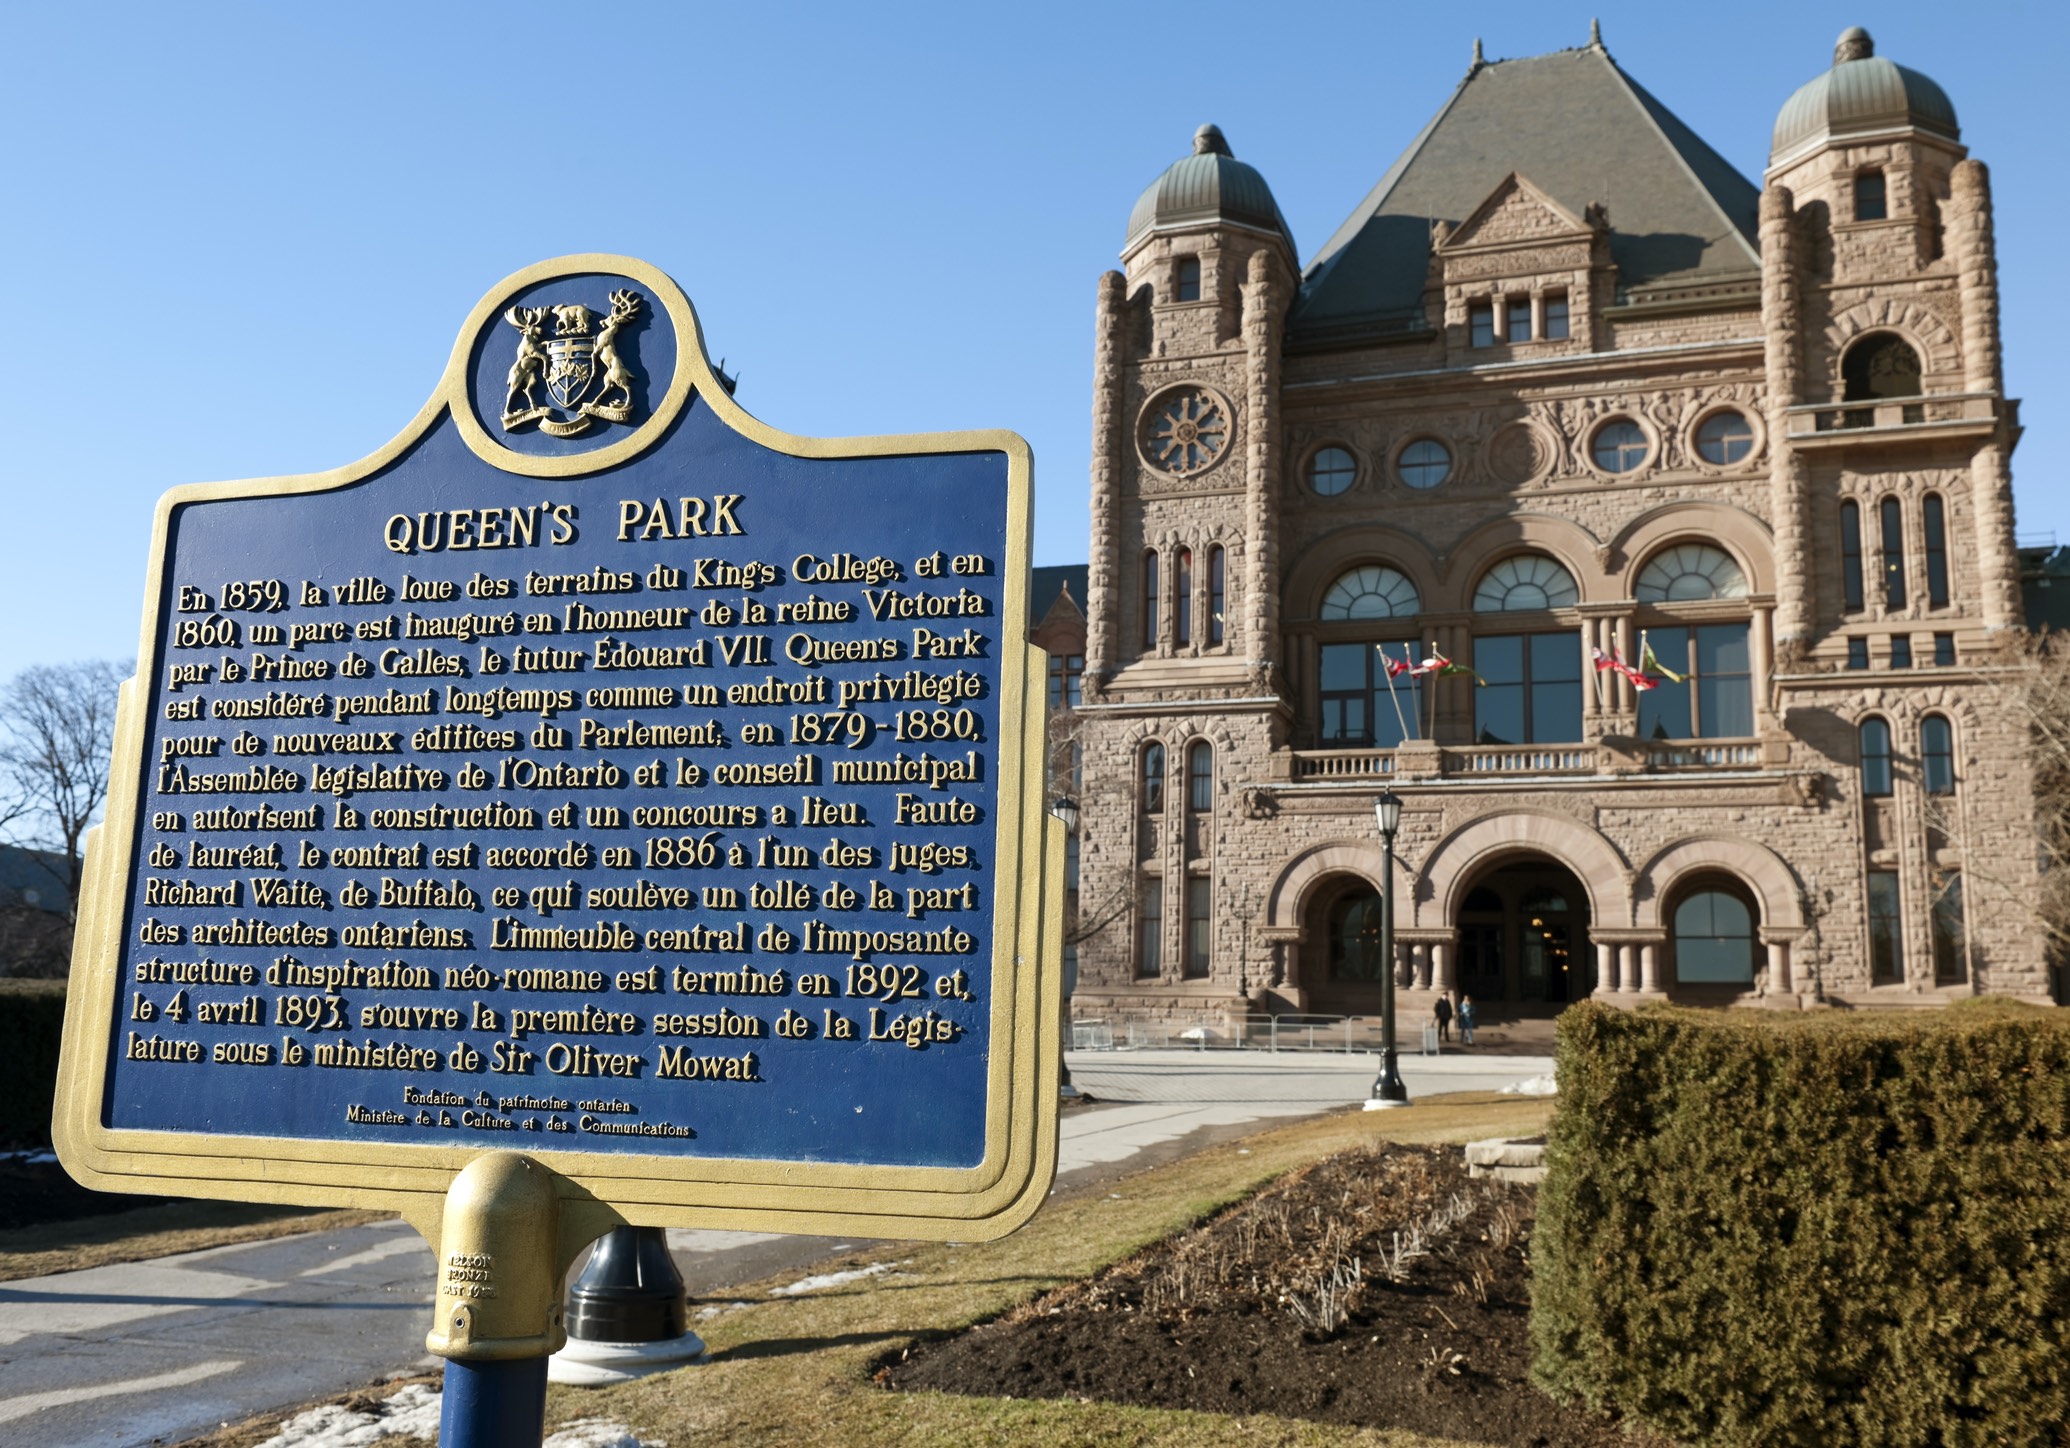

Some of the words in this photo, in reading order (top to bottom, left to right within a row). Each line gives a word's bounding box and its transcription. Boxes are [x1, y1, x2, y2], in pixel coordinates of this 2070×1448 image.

[383, 501, 573, 554] QUEEN'S
[617, 494, 742, 540] PARK
[176, 585, 207, 611] En
[219, 579, 283, 610] 1859,
[298, 580, 322, 605] la
[332, 576, 387, 603] ville
[399, 575, 453, 601] loue
[465, 572, 510, 598] des
[524, 566, 634, 595] terrains
[645, 563, 679, 589] du
[692, 559, 776, 590] King's
[791, 553, 900, 585] College,
[914, 552, 941, 577] et
[950, 554, 985, 574] en
[173, 611, 236, 647] 1860,
[248, 625, 279, 644] un
[287, 622, 345, 650] parc
[354, 616, 393, 640] est
[404, 612, 515, 641] inauguré
[522, 613, 553, 633] en
[563, 602, 689, 631] l'honneur
[699, 599, 732, 625] de
[740, 597, 767, 624] la
[776, 594, 850, 623] reine
[862, 588, 985, 618] Victoria
[167, 663, 209, 690] par
[218, 655, 240, 681] le
[249, 653, 328, 680] Prince
[338, 652, 367, 677] de
[378, 647, 465, 676] Galles,
[478, 646, 501, 673] le
[512, 646, 584, 672] futur
[592, 636, 706, 669] Édouard
[715, 635, 768, 665] VII.
[784, 632, 898, 666] Queen's
[911, 628, 982, 658] Park
[163, 697, 200, 720] est
[210, 691, 325, 718] considéré
[333, 688, 432, 723] pendant
[443, 685, 573, 718] longtemps
[584, 687, 674, 708] comme
[683, 685, 719, 705] un
[726, 674, 826, 704] endroit
[837, 670, 981, 709] privilégié
[159, 736, 219, 763] pour
[230, 732, 259, 755] de
[271, 732, 396, 754] nouveaux
[410, 723, 516, 751] édifices
[529, 722, 563, 749] du
[578, 718, 722, 748] Parlement;
[740, 723, 775, 744] en
[156, 764, 298, 793] l'Assemblée
[310, 763, 443, 797] législative
[455, 761, 486, 789] de
[497, 757, 620, 788] l'Ontario
[633, 761, 661, 786] et
[675, 757, 701, 785] le
[712, 753, 814, 785] conseil
[832, 751, 977, 789] municipal
[151, 812, 179, 831] en
[191, 803, 317, 830] autorisent
[333, 801, 359, 829] la
[368, 801, 534, 829] construction
[546, 804, 572, 827] et
[585, 807, 620, 827] un
[631, 805, 758, 827] concours
[770, 805, 787, 825] a
[801, 796, 866, 825] lieu.
[894, 793, 976, 824] Faute
[147, 843, 175, 867] de
[186, 841, 280, 869] lauréat,
[297, 840, 321, 867] le
[329, 843, 421, 868] contrat
[430, 844, 472, 867] est
[485, 840, 589, 867] accordé
[600, 847, 632, 867] en
[645, 831, 725, 867] 1886
[727, 843, 744, 867] à
[756, 836, 810, 867] l'un
[820, 838, 873, 867] des
[144, 877, 237, 906] Richard
[249, 878, 326, 909] Waite,
[338, 879, 369, 907] de
[378, 877, 476, 910] Buffalo,
[490, 887, 520, 907] ce
[528, 880, 573, 915] qui
[586, 879, 690, 908] soulève
[702, 887, 738, 909] un
[749, 879, 811, 909] tollé
[821, 881, 856, 909] de
[868, 879, 895, 909] la
[906, 883, 972, 918] part
[138, 918, 180, 944] des
[190, 918, 329, 946] architectes
[340, 920, 468, 948] ontariens.
[489, 917, 636, 950] L'immeuble
[643, 922, 744, 951] central
[756, 923, 791, 952] de
[803, 920, 971, 960] l'imposante
[134, 959, 254, 984] structure
[264, 955, 431, 994] d'inspiration
[443, 967, 602, 991] néo-romane
[614, 967, 658, 991] est
[671, 965, 784, 994] terminé
[796, 974, 832, 995] en
[845, 964, 920, 1002] 1892
[934, 970, 969, 1001] et,
[130, 992, 153, 1021] le
[163, 989, 183, 1021] 4
[196, 996, 258, 1024] avril
[274, 995, 343, 1030] 1893,
[359, 1004, 459, 1028] s'ouvre
[471, 1001, 497, 1030] la
[510, 1005, 636, 1039] première
[652, 1007, 760, 1036] session
[773, 1009, 809, 1038] de
[823, 1009, 852, 1039] la
[126, 1031, 200, 1061] lature
[212, 1043, 269, 1064] sous
[280, 1036, 303, 1065] le
[313, 1039, 437, 1070] ministère
[447, 1042, 480, 1071] de
[489, 1041, 532, 1073] Sir
[544, 1042, 640, 1076] Oliver
[654, 1046, 759, 1081] Mowat.
[346, 1105, 405, 1124] Ministère
[415, 1110, 430, 1125] de
[438, 1110, 451, 1126] la
[462, 1111, 511, 1129] Culture
[522, 1117, 534, 1130] et
[546, 1115, 567, 1131] des
[579, 1115, 689, 1136] Communications
[404, 1086, 464, 1105] Fondation
[475, 1091, 489, 1107] du
[499, 1096, 568, 1111] patrimoine
[578, 1098, 631, 1112] ontarien
